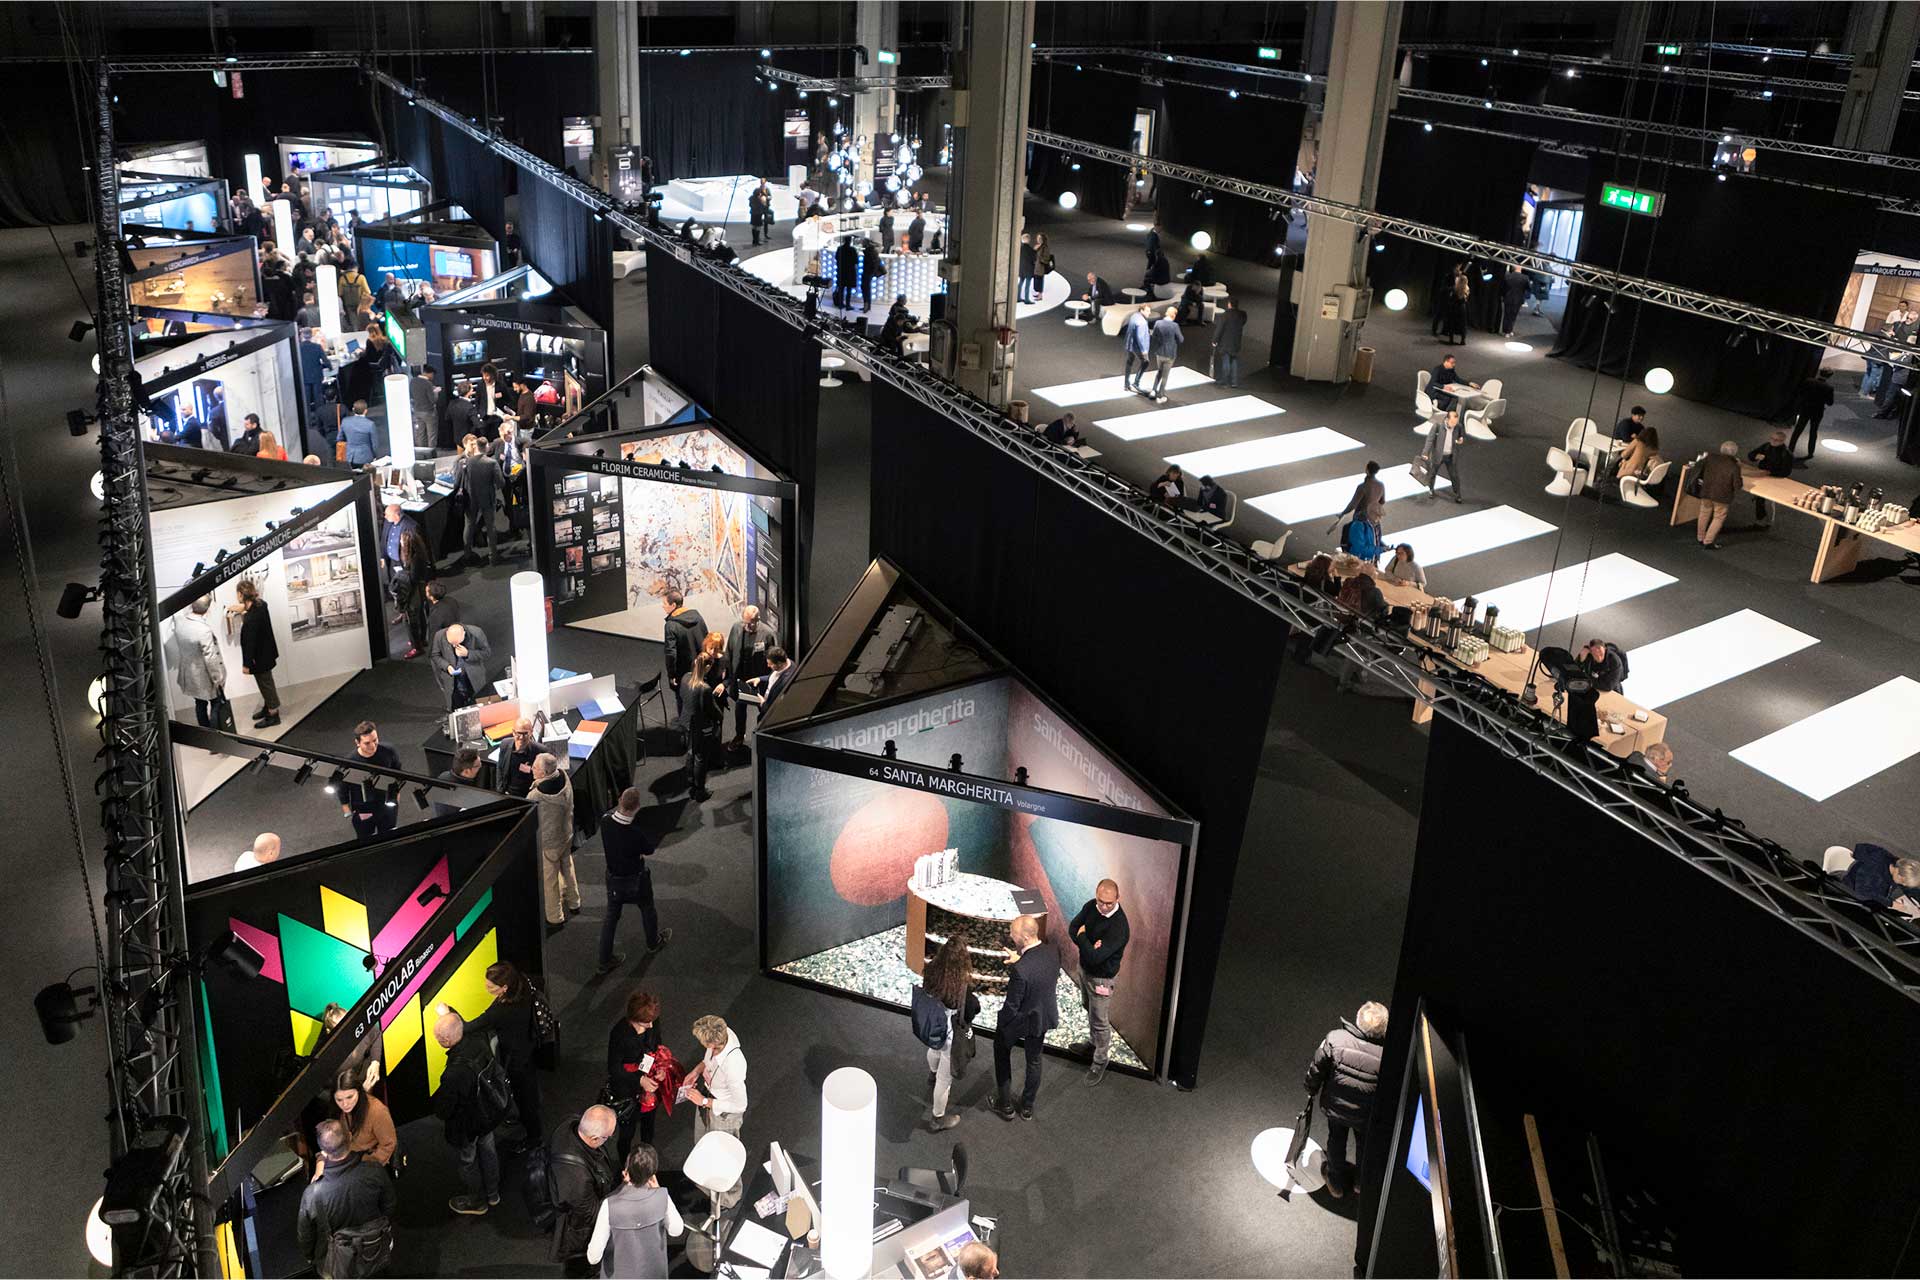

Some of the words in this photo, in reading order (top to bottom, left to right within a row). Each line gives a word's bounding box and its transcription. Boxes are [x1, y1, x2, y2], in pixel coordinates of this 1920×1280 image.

[1872, 267, 1897, 275] PARQUET
[477, 318, 513, 330] PILKINGTON
[512, 322, 532, 332] ITALIA
[601, 462, 631, 475] FLORIM
[633, 467, 680, 482] CERAMICHE
[223, 553, 250, 579] FLORIM
[251, 528, 292, 559] CERAMICHE
[812, 698, 976, 750] antamargherita
[1034, 713, 1142, 811] santamargherit
[869, 767, 879, 777] 64
[883, 766, 925, 787] SANTA
[928, 775, 1014, 806] MARGHERITA
[355, 1022, 365, 1039] 63
[366, 958, 415, 1025] FONOLAB
[415, 943, 435, 968] Binasco
